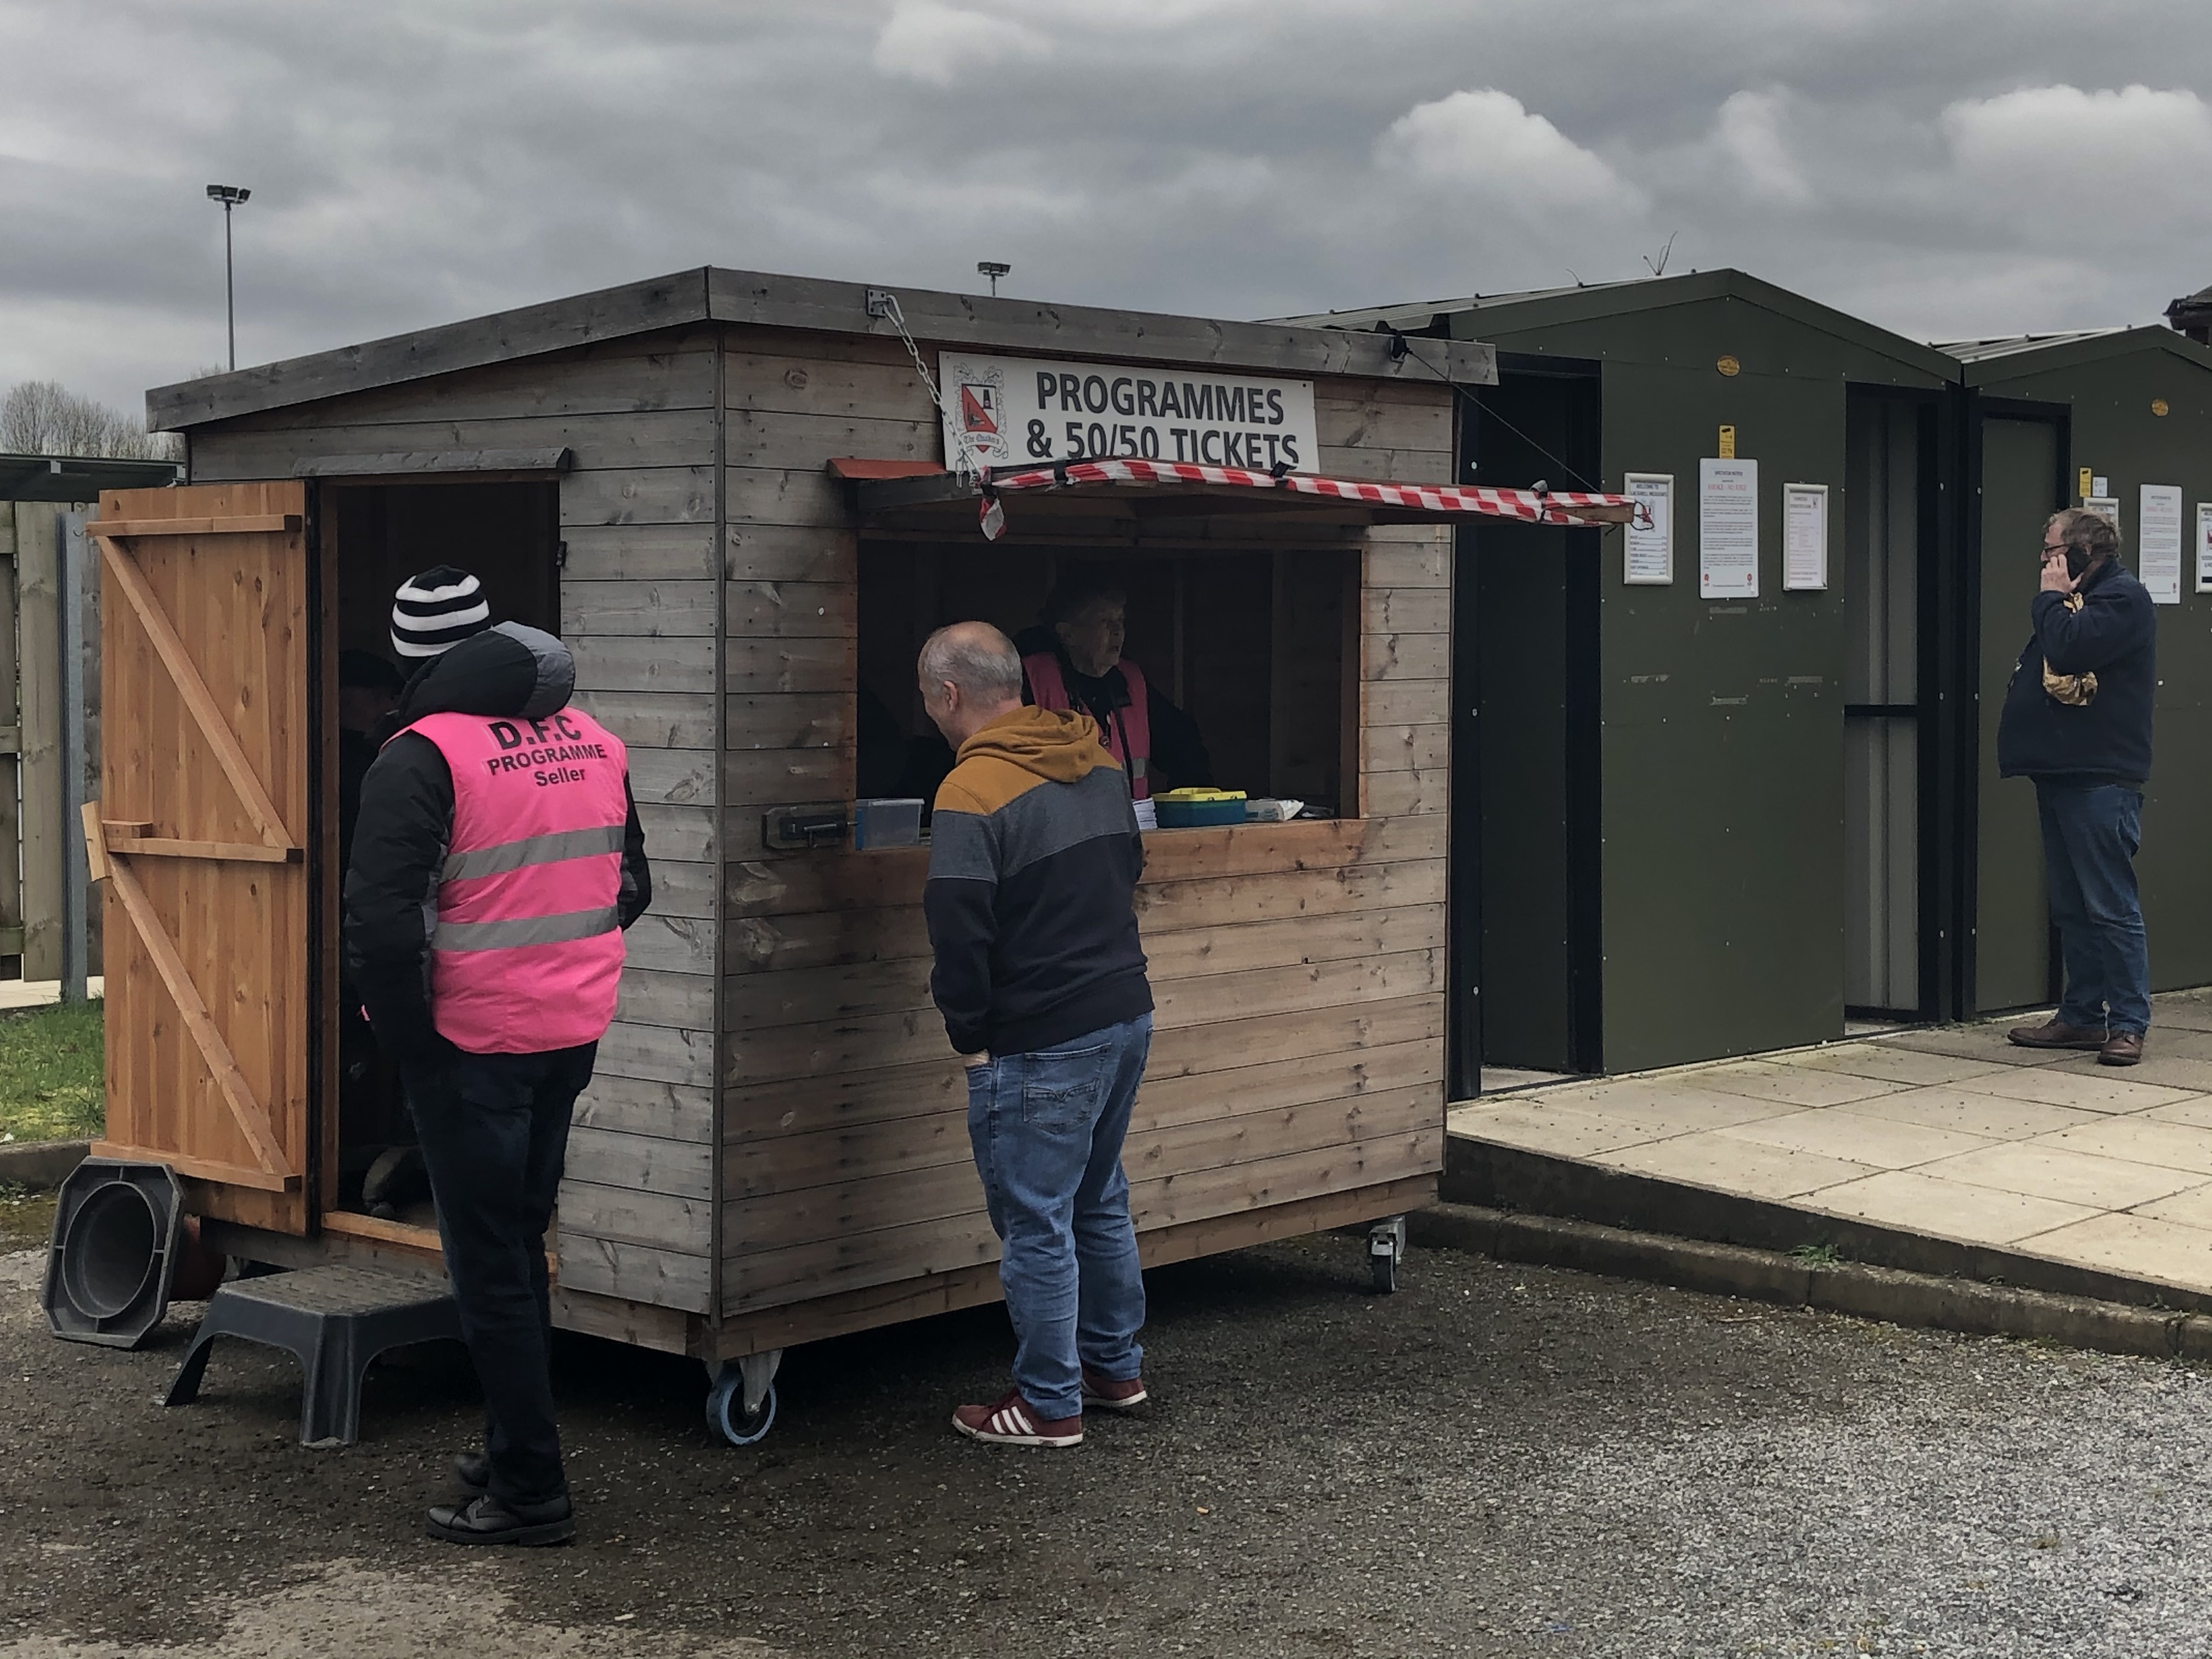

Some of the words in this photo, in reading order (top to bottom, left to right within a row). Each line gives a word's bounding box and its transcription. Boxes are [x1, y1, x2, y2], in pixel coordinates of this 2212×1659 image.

[1036, 371, 1284, 425] PROGRAMMES
[1027, 419, 1053, 458] &
[1066, 422, 1159, 459] 50/50
[1170, 428, 1298, 469] TICKETS
[487, 744, 607, 776] PROGRAMME
[534, 768, 585, 787] Seller
